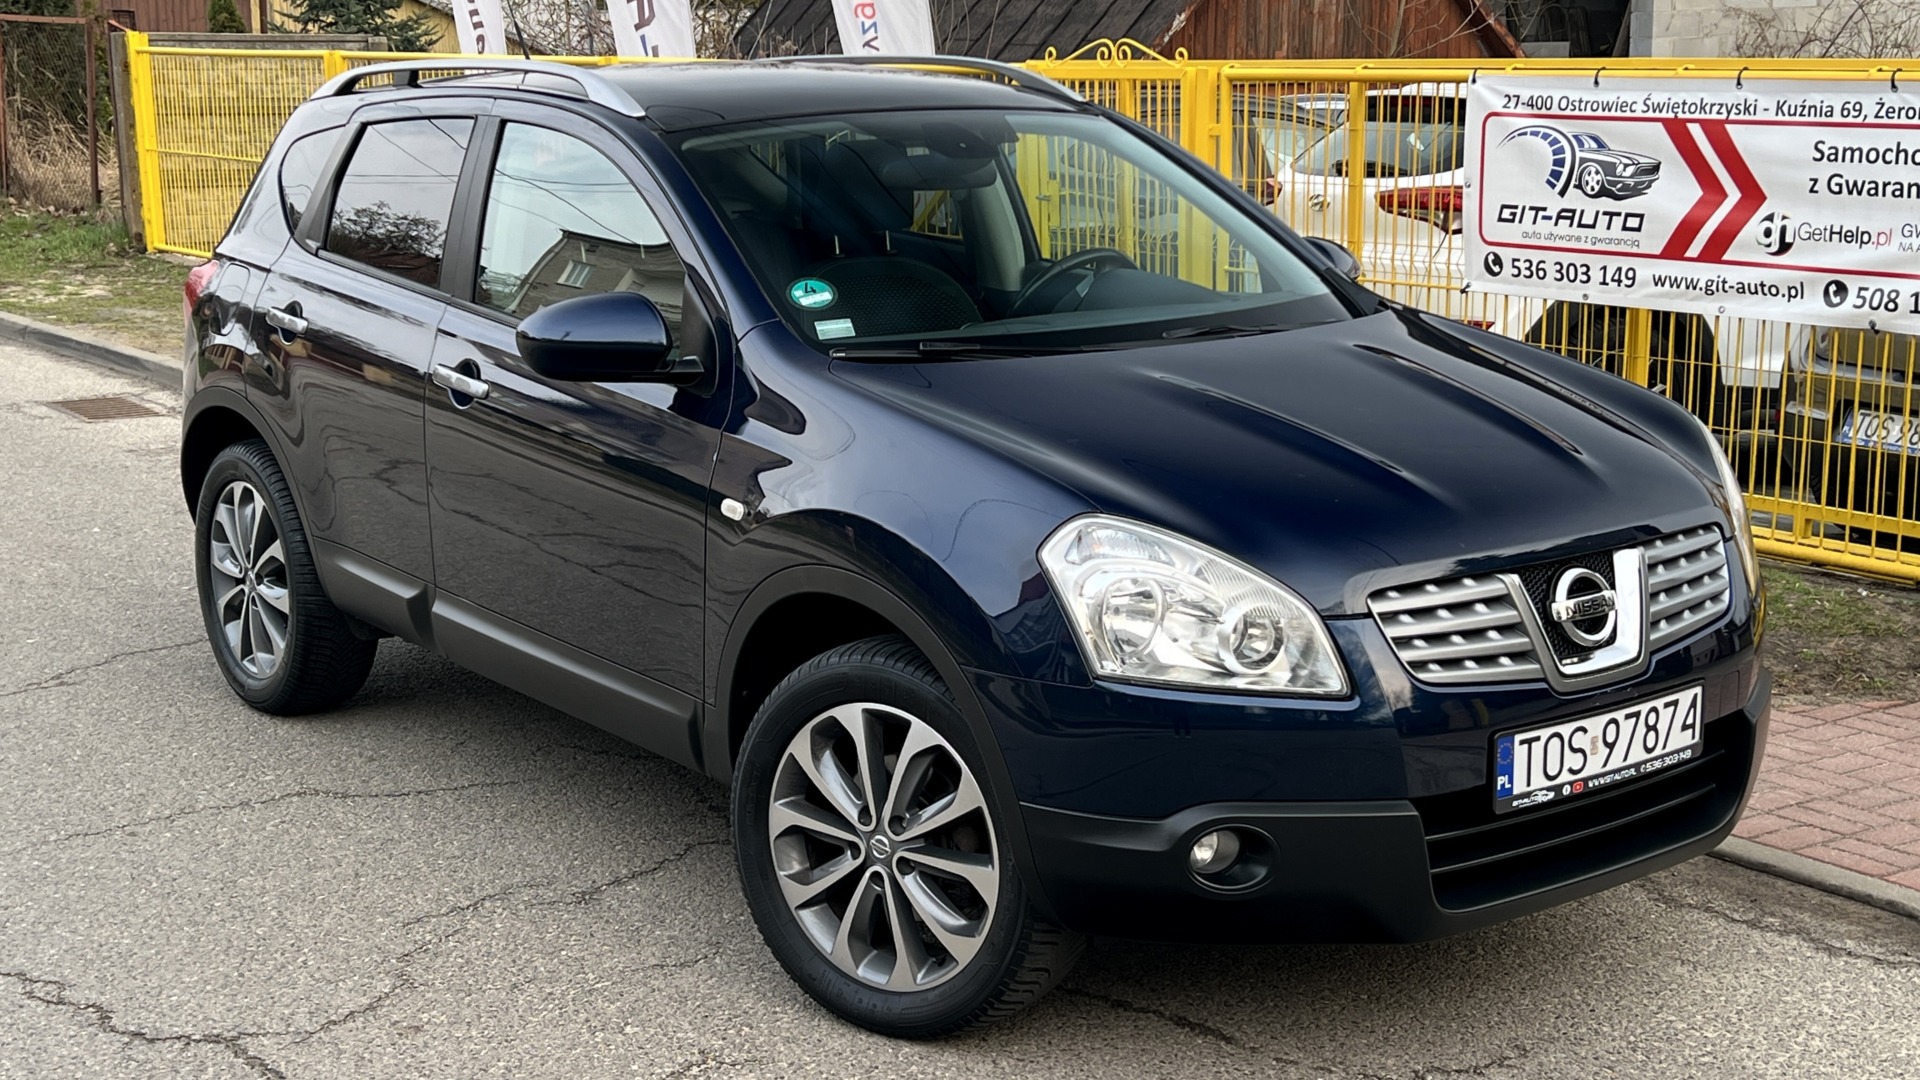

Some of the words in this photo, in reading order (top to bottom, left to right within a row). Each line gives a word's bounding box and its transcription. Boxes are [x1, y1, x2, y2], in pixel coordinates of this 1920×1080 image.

[1502, 94, 1553, 110] 27-400
[1558, 95, 1637, 113] Ostrowiec
[1641, 93, 1758, 120] Świętokrzyski
[1775, 99, 1834, 117] Kuźnia
[1840, 101, 1868, 122] 69,
[1874, 97, 1920, 120] Żero
[1808, 177, 1819, 194] z
[1497, 204, 1645, 232] GIT-AUTO
[1522, 230, 1542, 240] auta
[1544, 231, 1582, 243] używane
[1591, 236, 1640, 249] gwarancją
[1798, 222, 1893, 250] GetHelp.pl
[1511, 258, 1547, 280] 536
[1553, 261, 1591, 284] 303
[1599, 265, 1637, 288] 149
[1652, 274, 1805, 302] www.git-auto.pl
[1852, 286, 1900, 313] 508
[1566, 595, 1615, 618] NISSAN
[1519, 726, 1588, 787] TOS
[1601, 692, 1699, 769] 97874
[1497, 774, 1511, 790] PL
